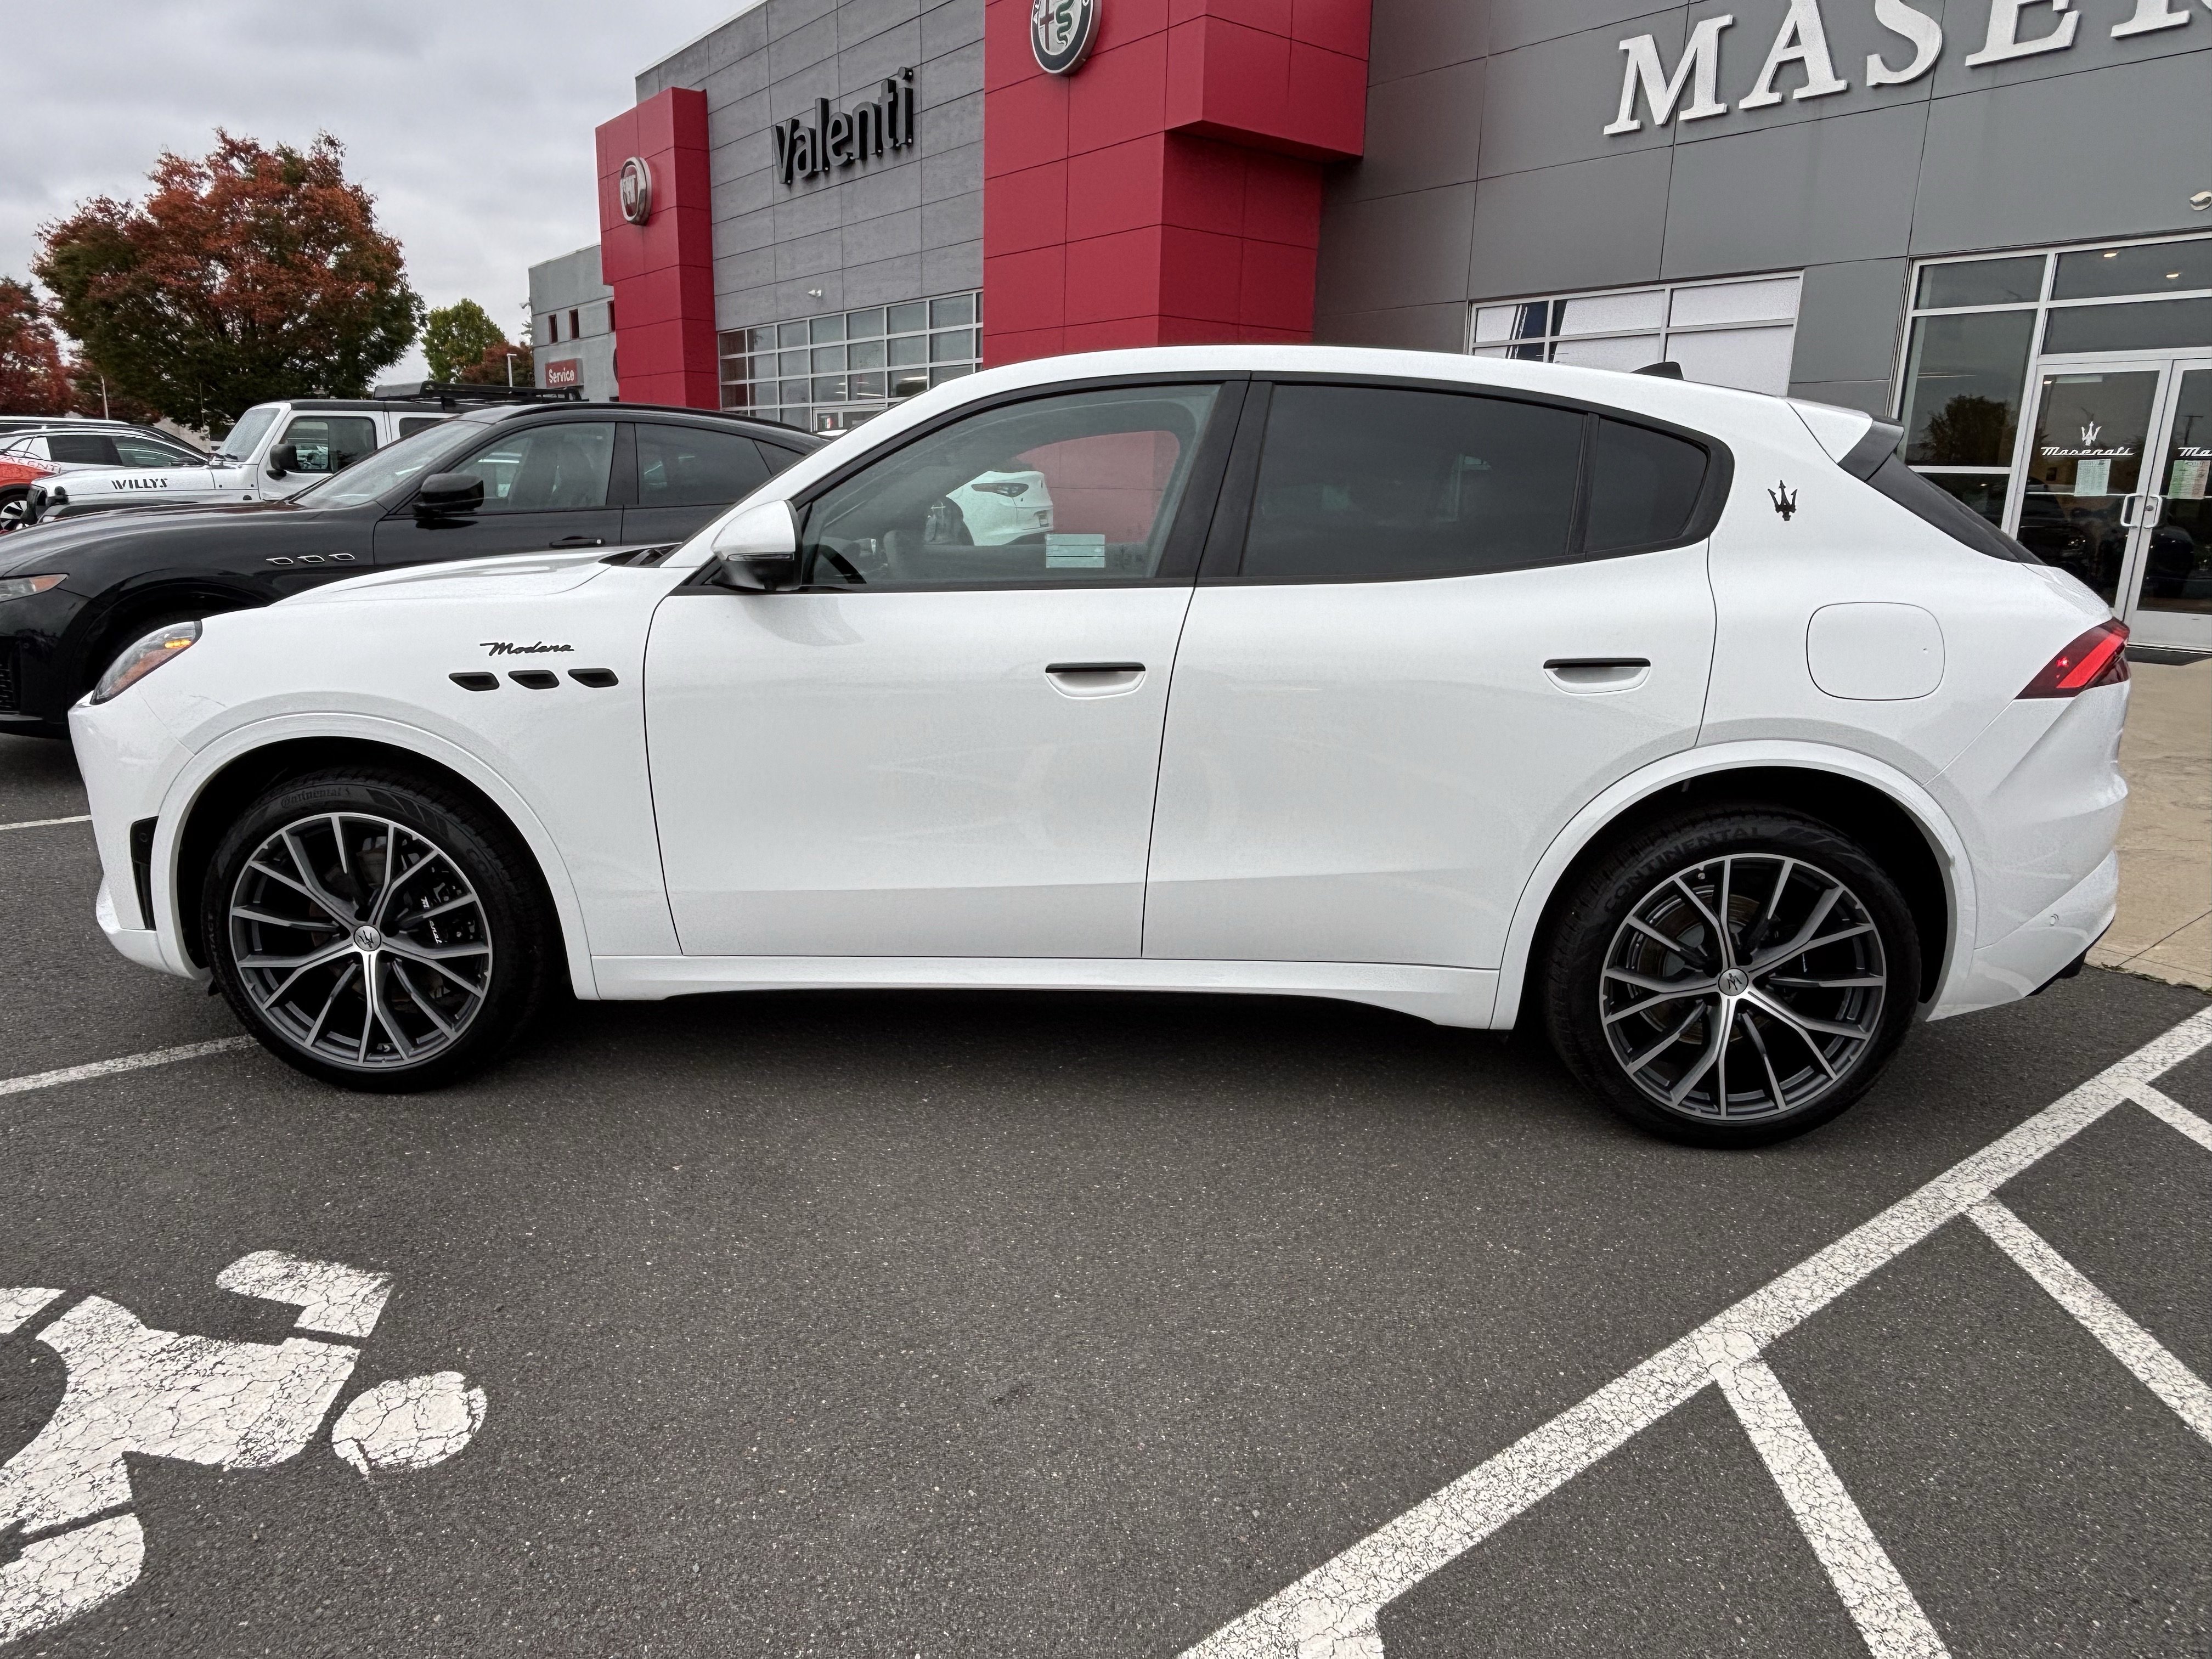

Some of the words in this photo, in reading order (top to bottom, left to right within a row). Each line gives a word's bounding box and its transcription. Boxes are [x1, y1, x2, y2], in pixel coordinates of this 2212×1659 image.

[772, 66, 913, 185] Valenti
[2040, 446, 2136, 456] Maserati
[111, 478, 168, 490] WILLYS
[479, 641, 575, 657] Modena
